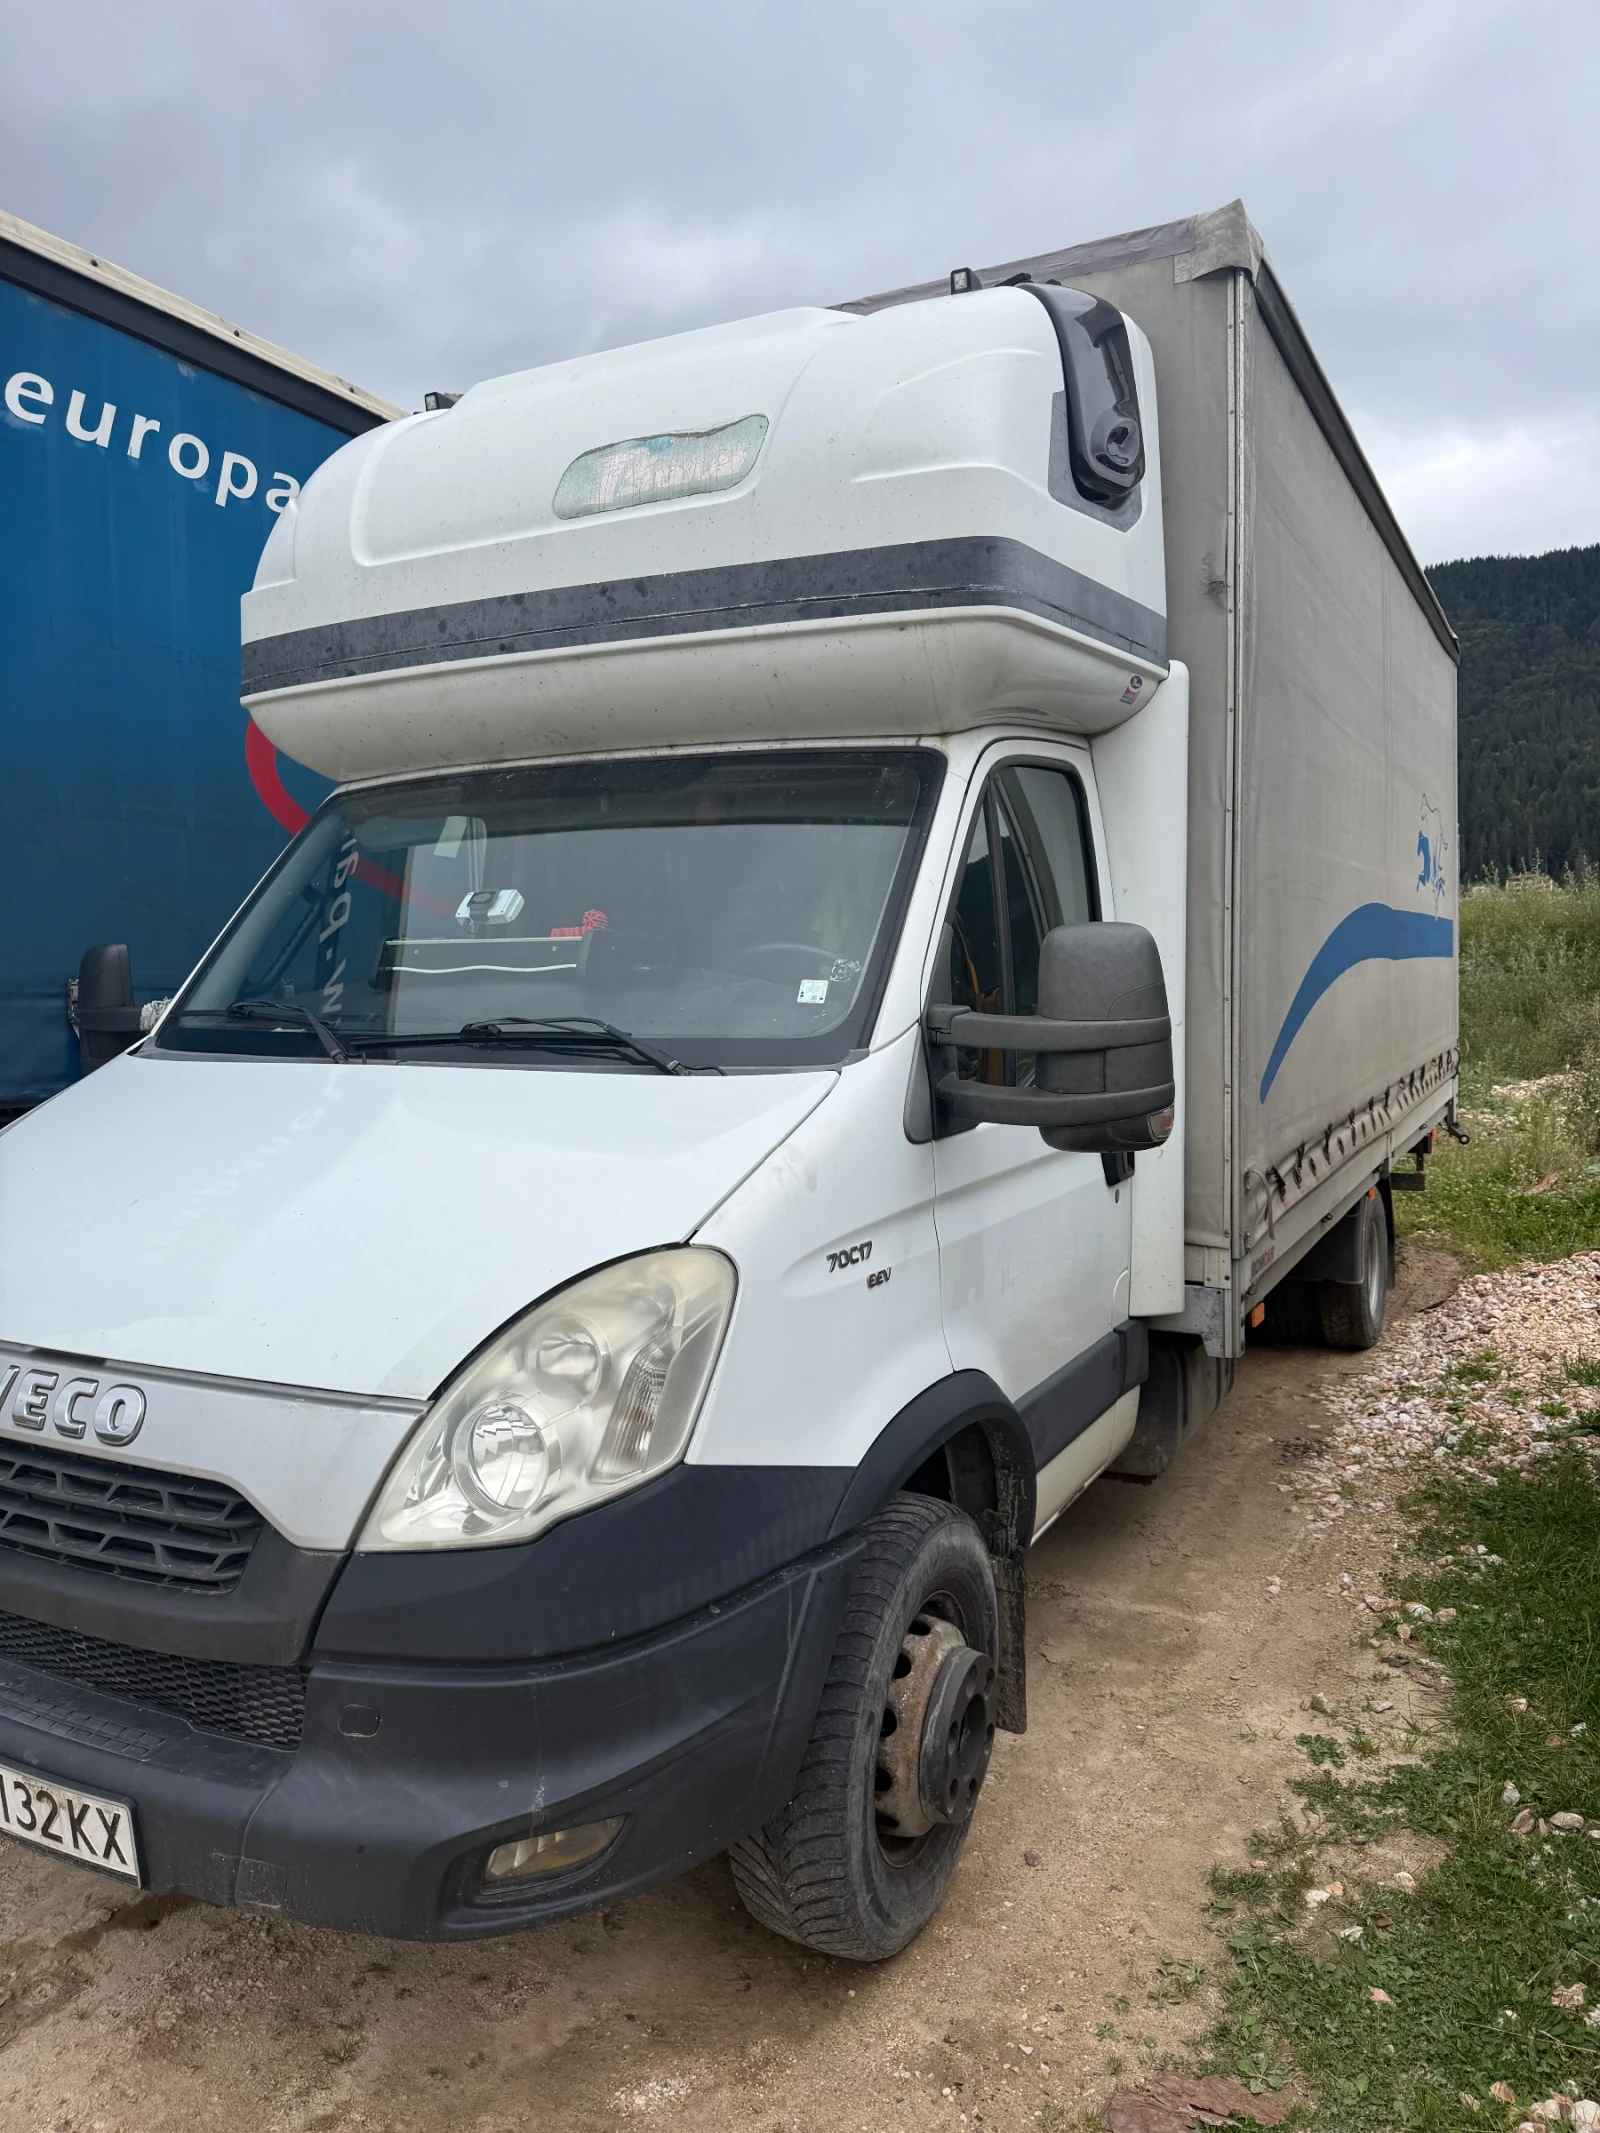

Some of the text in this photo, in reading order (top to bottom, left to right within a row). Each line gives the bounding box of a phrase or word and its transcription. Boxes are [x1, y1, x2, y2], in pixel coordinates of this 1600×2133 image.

[4, 371, 300, 513] europa
[826, 1240, 873, 1273] 70C17
[867, 1266, 892, 1289] EEV
